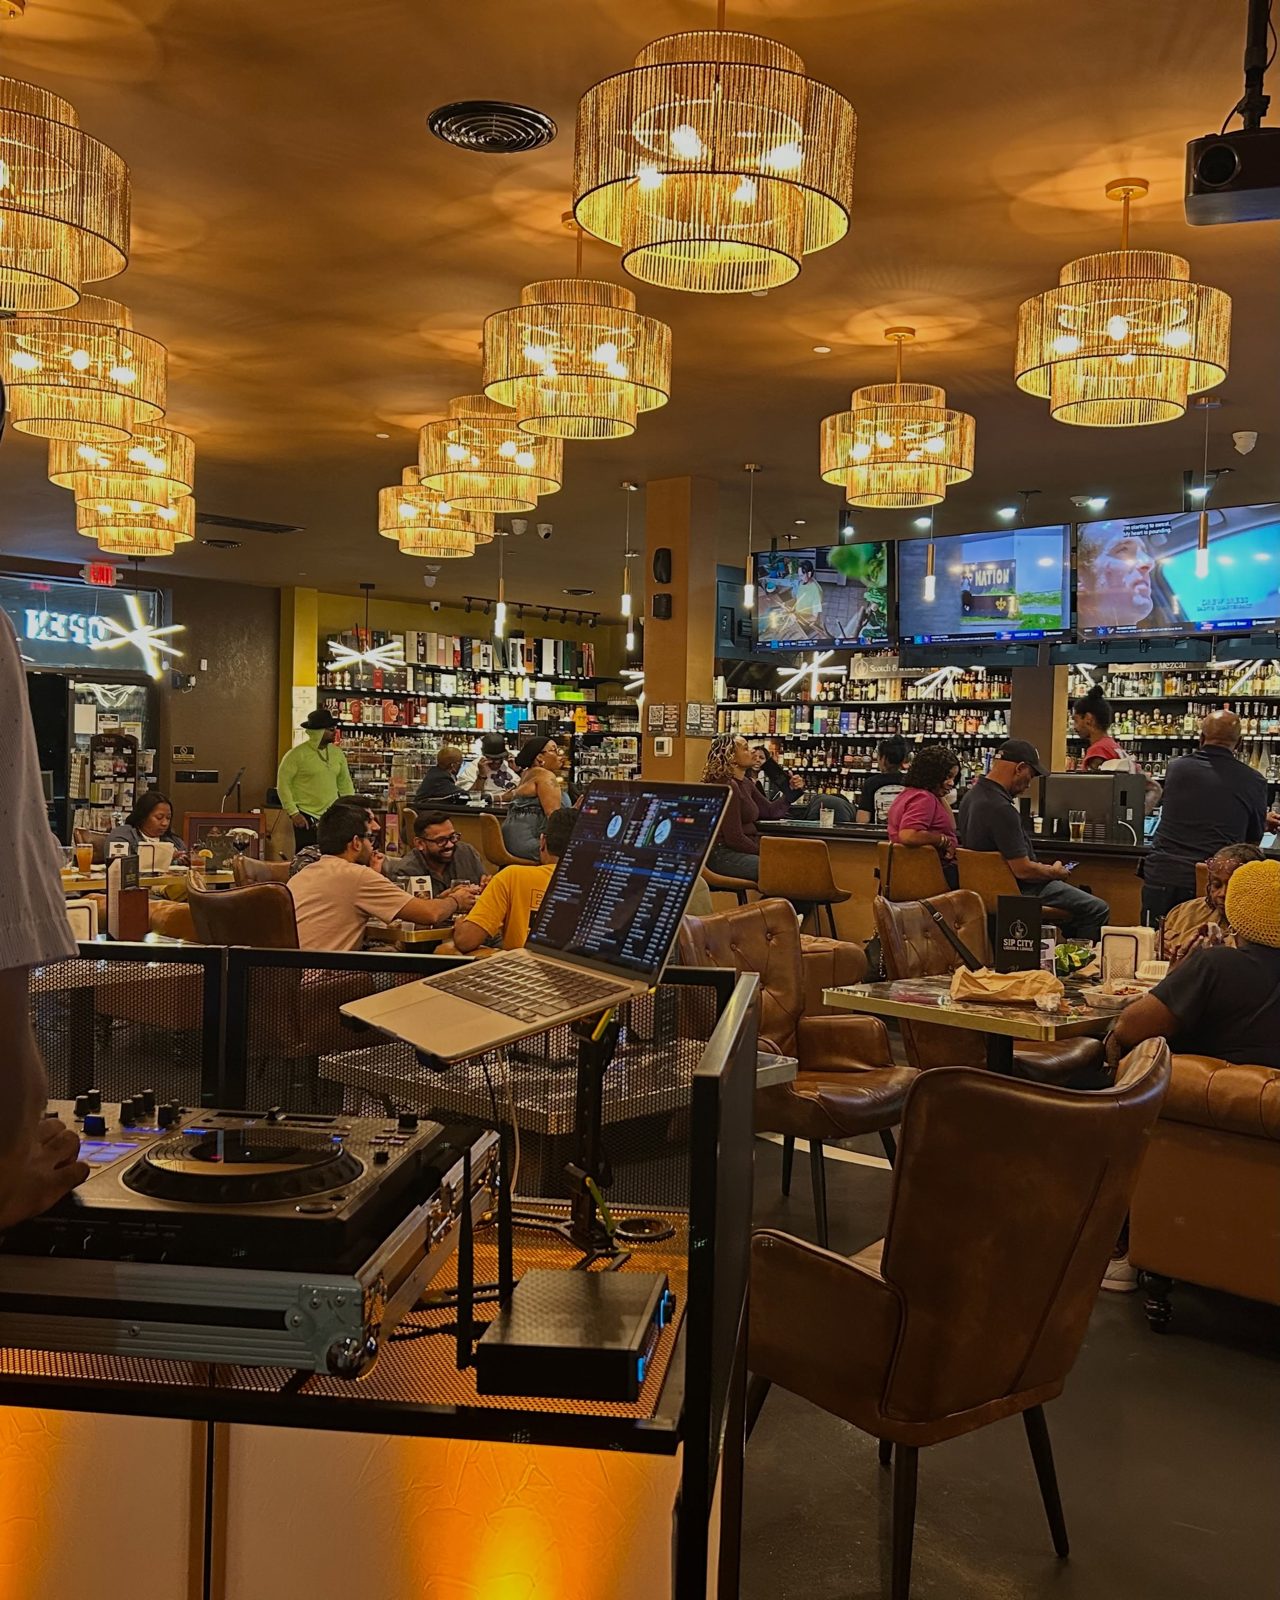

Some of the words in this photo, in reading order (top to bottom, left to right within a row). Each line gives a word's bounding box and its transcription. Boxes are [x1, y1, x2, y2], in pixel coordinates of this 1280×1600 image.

[90, 564, 112, 584] EXIT
[975, 568, 1010, 586] NATION
[869, 664, 891, 672] Scotch
[1159, 661, 1187, 669] Mezcal
[1003, 938, 1016, 946] SIP
[1016, 939, 1034, 947] CITY
